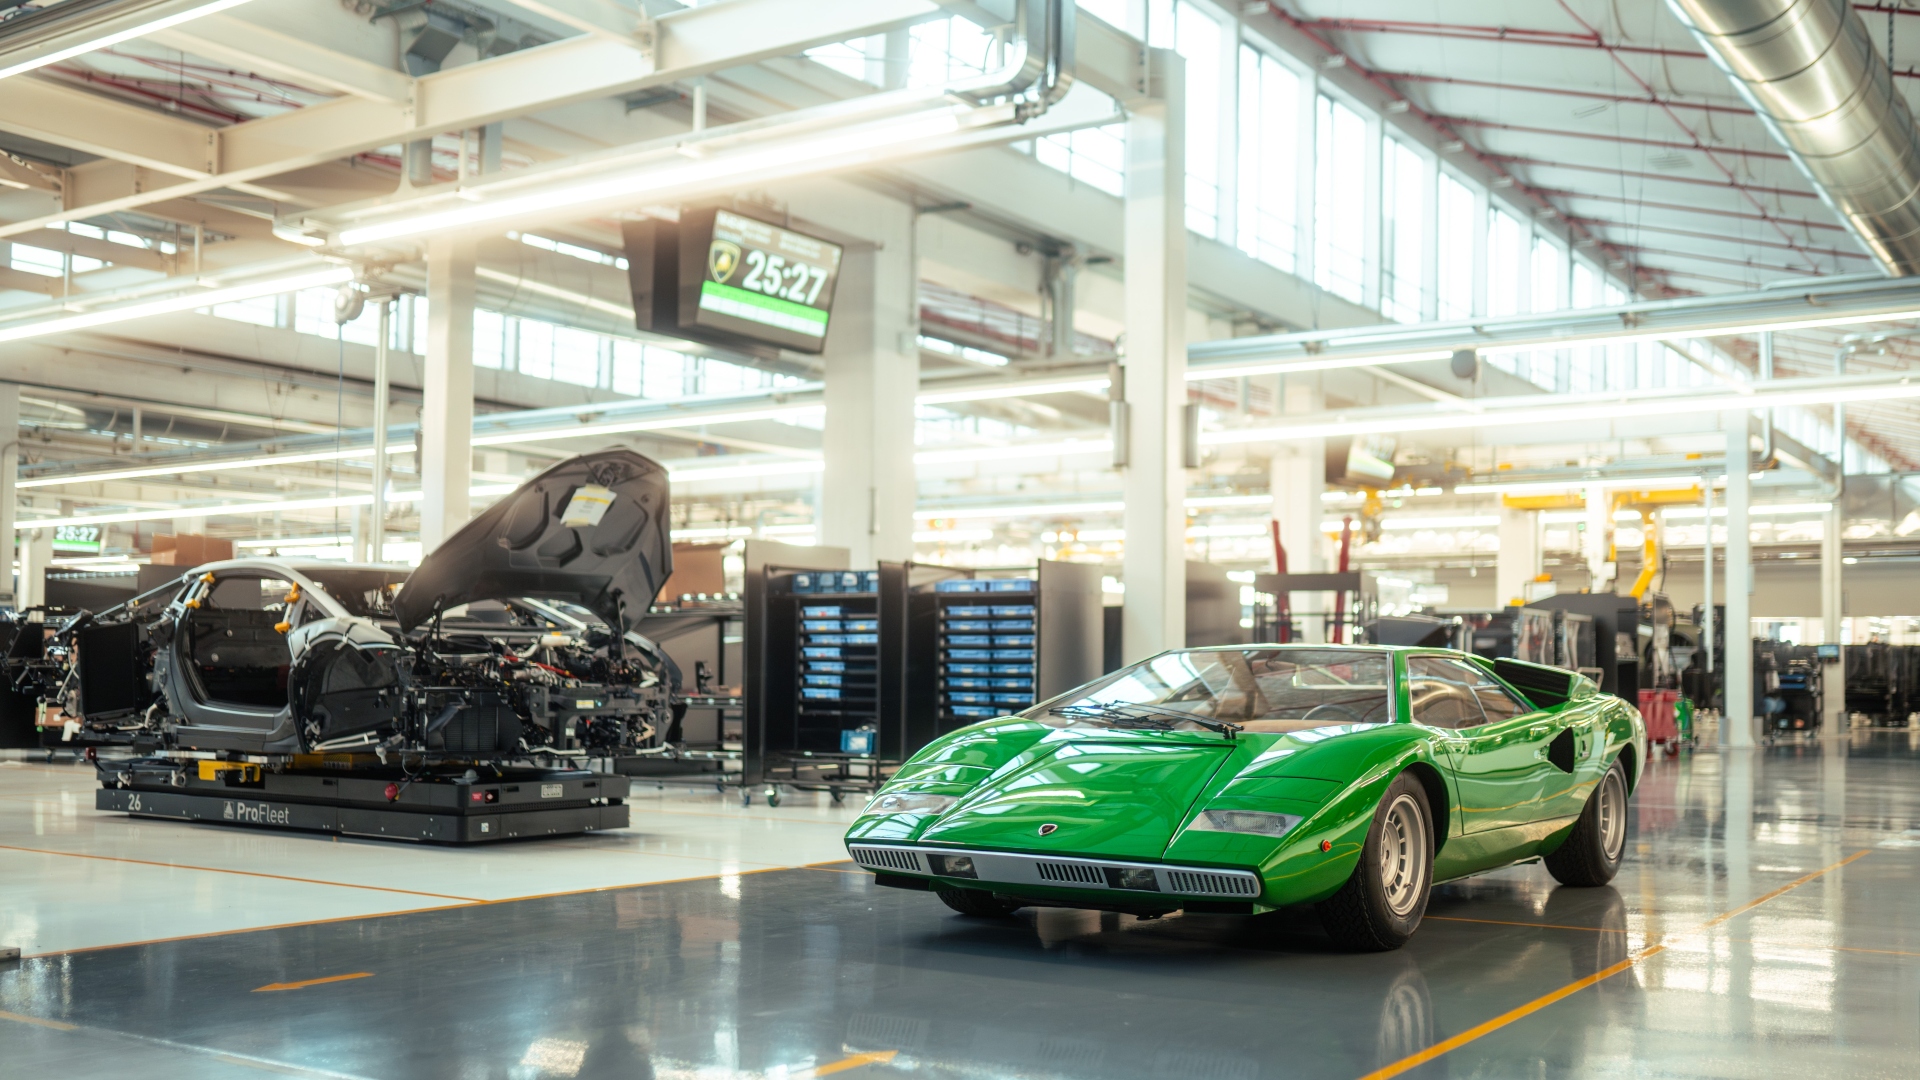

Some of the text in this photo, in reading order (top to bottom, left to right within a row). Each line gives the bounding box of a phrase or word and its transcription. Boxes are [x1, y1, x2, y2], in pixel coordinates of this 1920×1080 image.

[742, 250, 828, 305] 25:27
[56, 526, 98, 541] 25:27
[128, 794, 141, 811] 26
[237, 802, 290, 824] ProFleet
